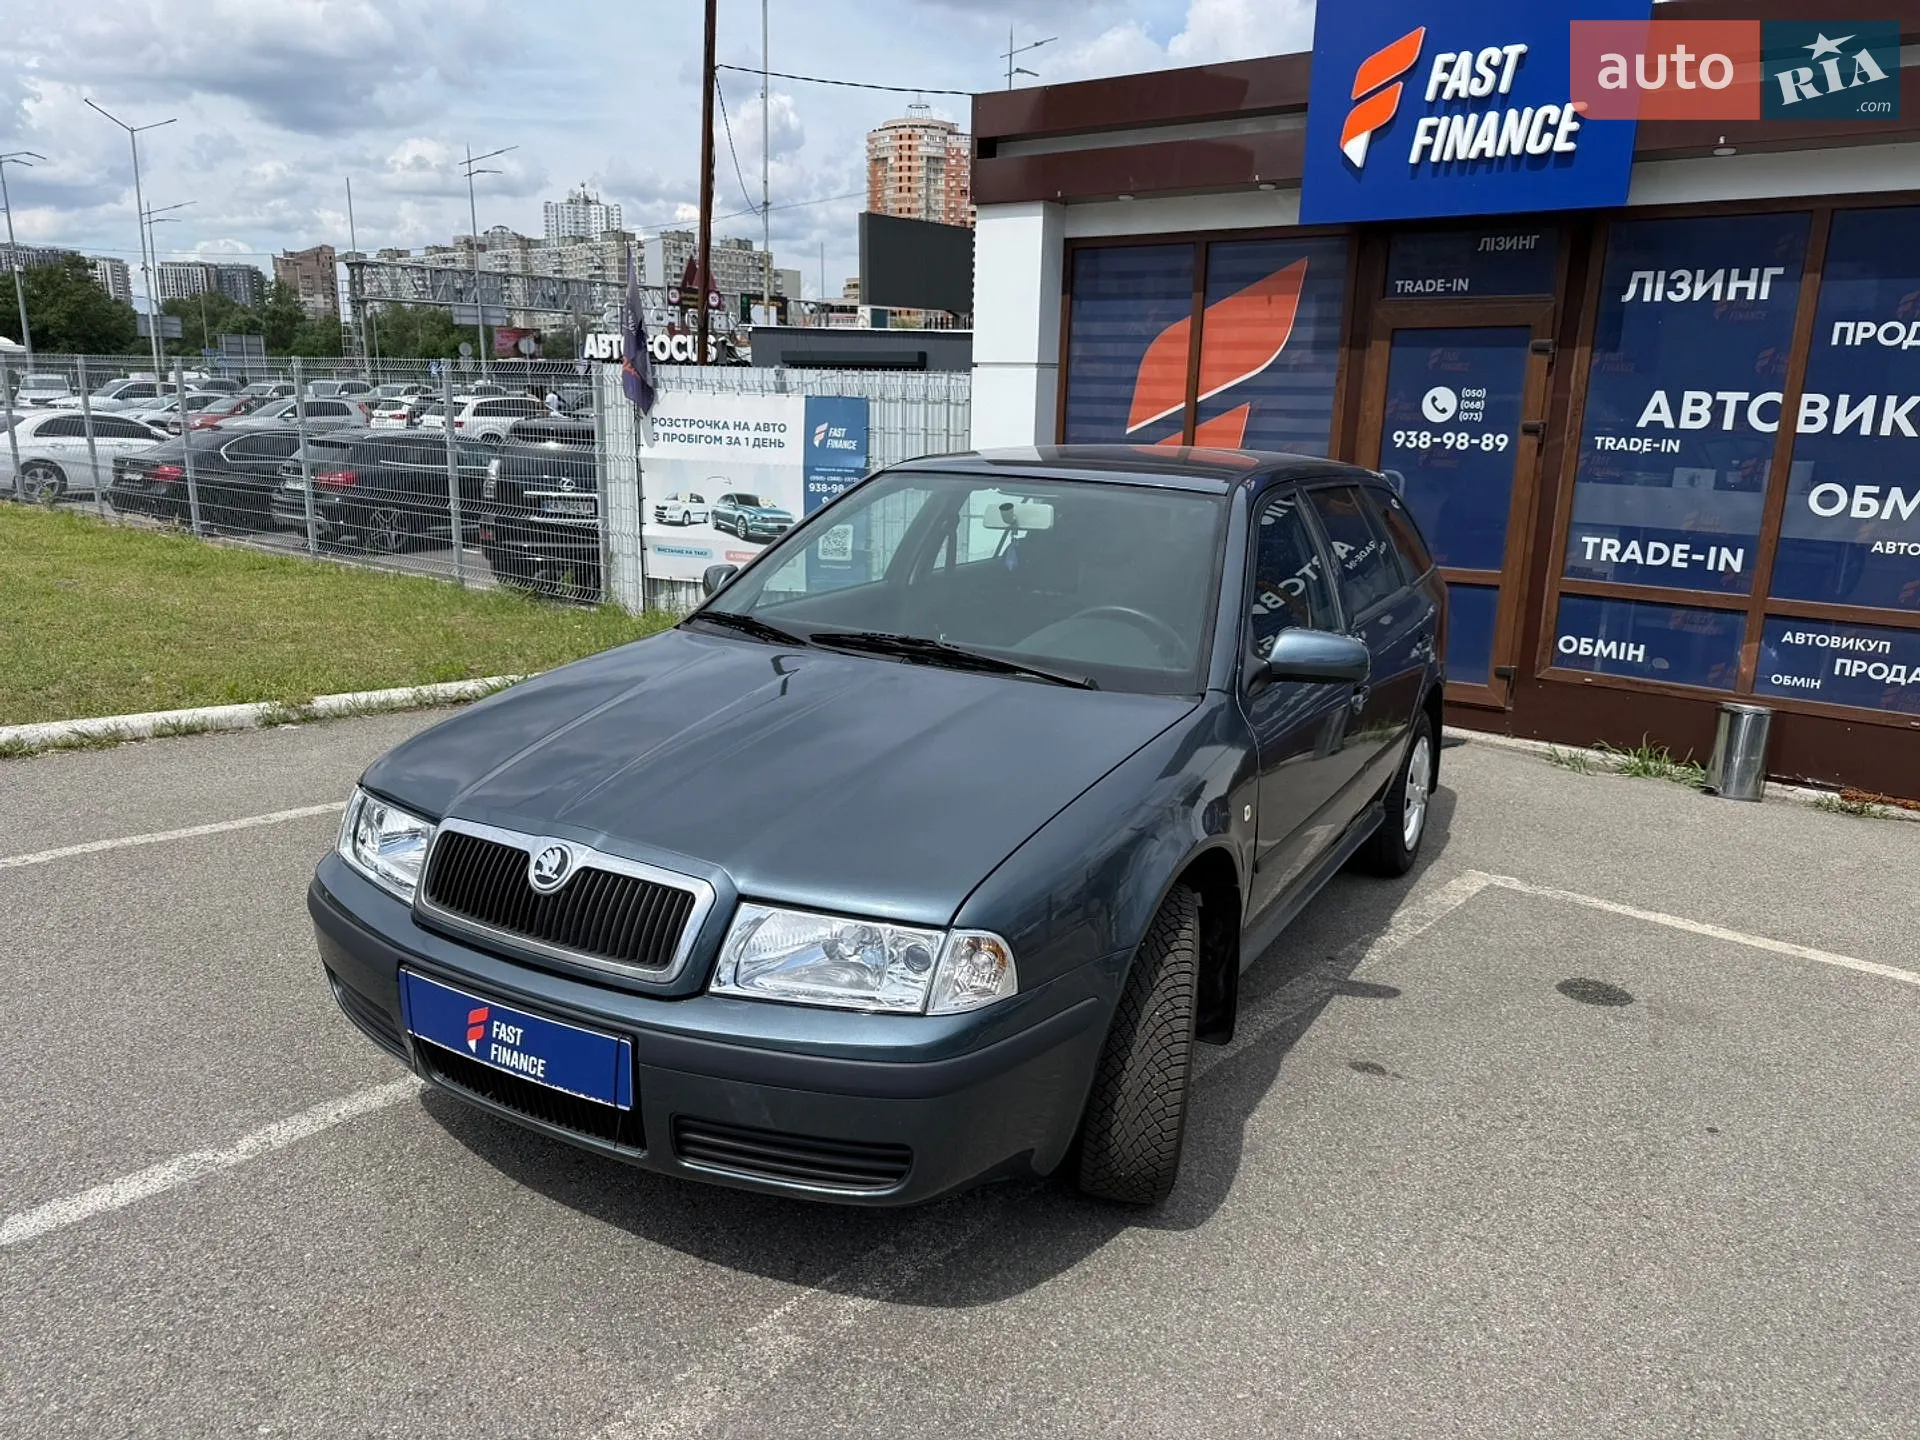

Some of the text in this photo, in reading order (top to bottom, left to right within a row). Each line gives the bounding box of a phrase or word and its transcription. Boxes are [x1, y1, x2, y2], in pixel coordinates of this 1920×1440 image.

[1425, 44, 1528, 102] FAST
[1409, 101, 1588, 164] FINANCE
[1477, 235, 1540, 252] ЛІЗИНГ
[1395, 278, 1470, 294] TRADE-IN
[1621, 266, 1785, 303] ЛІЗИНГ
[584, 333, 625, 361] АВТ
[1461, 387, 1487, 399] (050)
[1460, 399, 1485, 411] (068)
[651, 417, 787, 434] РОЗСТРОЧКА НА АВТО
[1458, 411, 1483, 423] (073)
[653, 432, 786, 449] З ПРОБІГОМ ЗА 1 ДЕНЬ
[827, 428, 848, 438] FAST
[1392, 431, 1509, 452] 938-98-89
[826, 439, 858, 451] FINANCE
[1595, 436, 1681, 453] TRADE-IN
[808, 483, 845, 494] 938-98
[1807, 482, 1920, 521] ОБМ
[1581, 536, 1745, 574] TRADE-IN
[1871, 540, 1920, 557] АВТО
[1558, 635, 1646, 663] ОБМІН
[1781, 630, 1892, 654] АВТОВИКУП
[1771, 674, 1822, 690] ОБМІН
[491, 1020, 524, 1046] FAST
[490, 1043, 547, 1078] FINANCE
